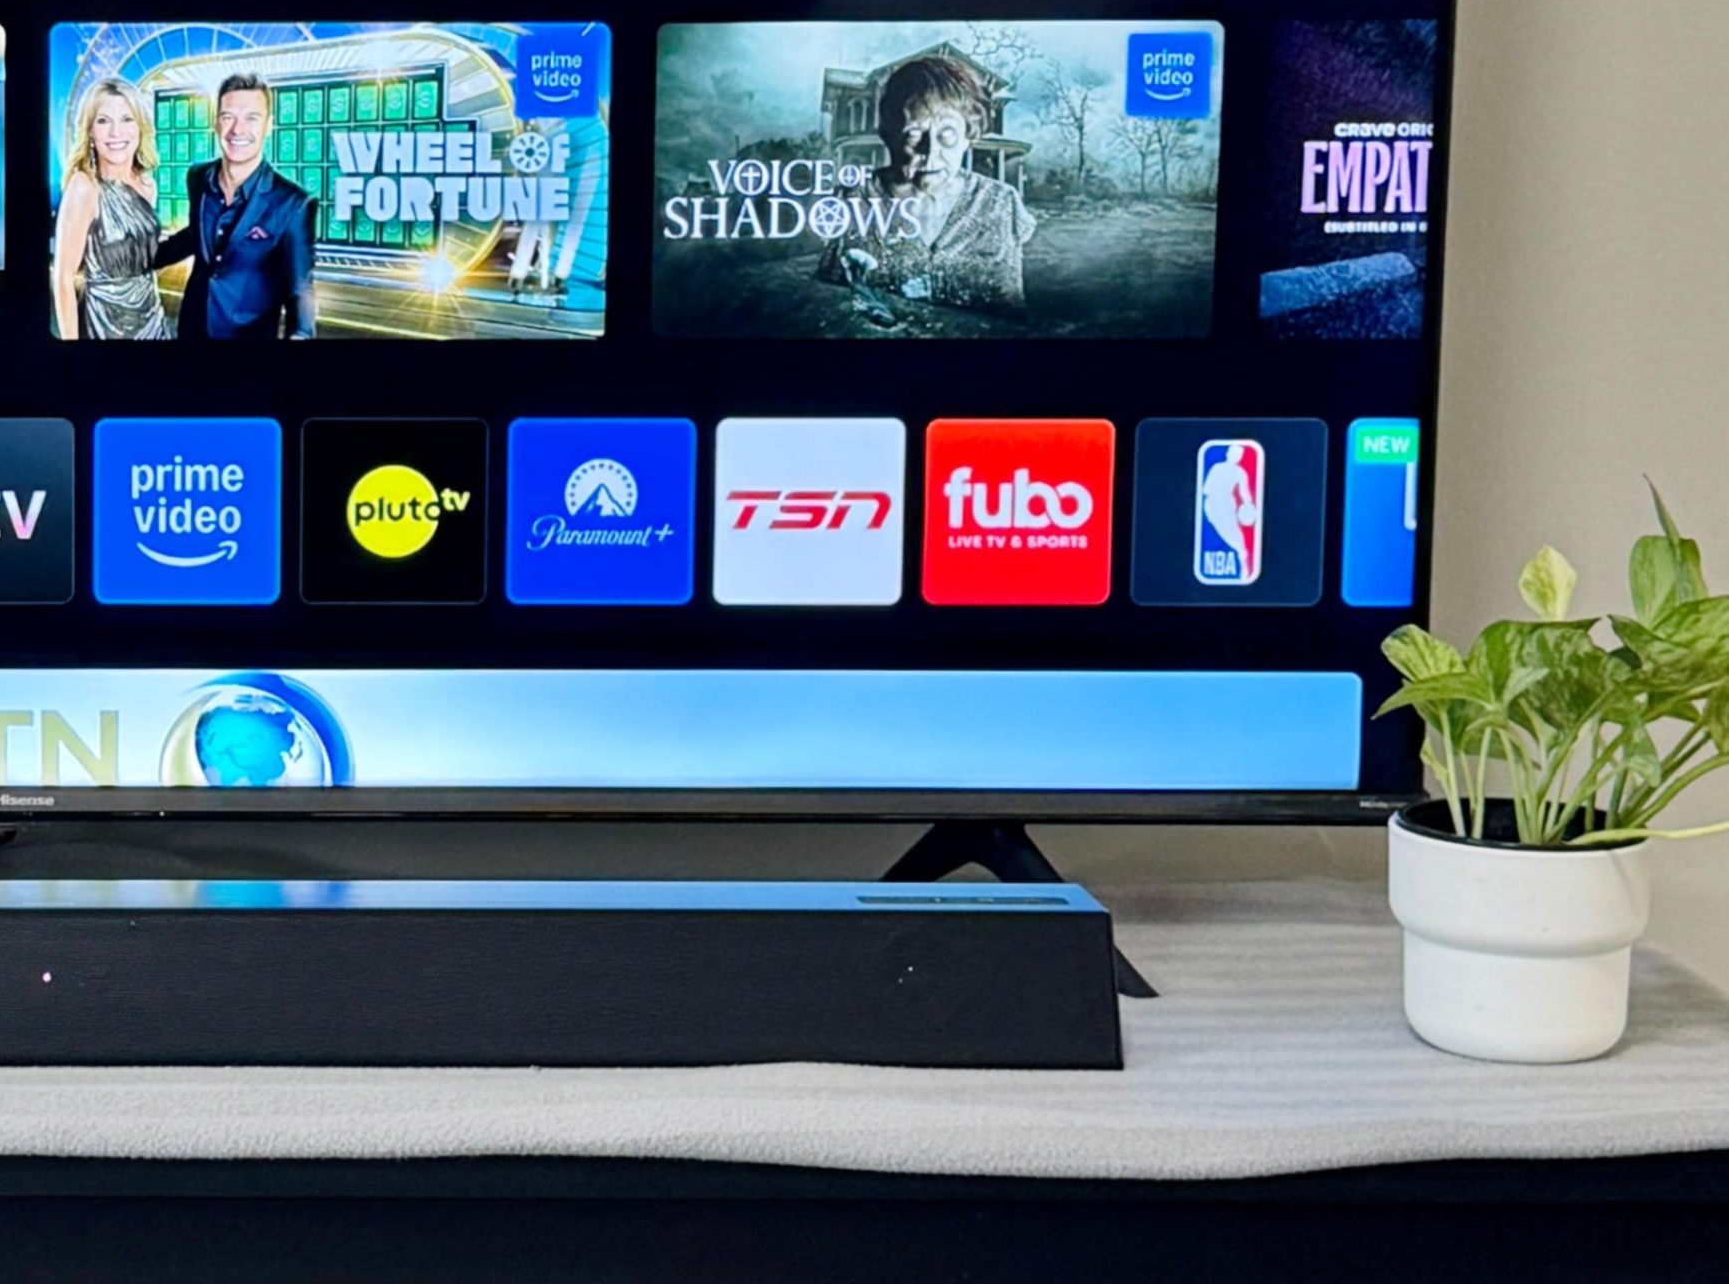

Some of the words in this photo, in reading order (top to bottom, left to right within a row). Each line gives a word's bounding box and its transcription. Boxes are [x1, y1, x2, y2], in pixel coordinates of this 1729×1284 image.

[531, 50, 583, 72] prime
[532, 69, 581, 88] video
[1141, 49, 1196, 71] prime
[1143, 68, 1195, 87] video
[332, 131, 502, 174] WHEEL
[707, 159, 836, 196] VOICE
[838, 164, 873, 188] OF
[334, 176, 571, 222] FORTUNE
[663, 196, 924, 240] SHADOWS
[1363, 435, 1410, 454] NEW
[131, 455, 245, 499] prime
[133, 496, 242, 534] video
[355, 496, 442, 527] pluto
[440, 487, 471, 512] tv
[726, 490, 892, 530] TSN
[943, 465, 1094, 529] fubo
[947, 535, 983, 549] LIVE
[986, 535, 1007, 549] TV
[1027, 535, 1089, 549] SPORTS
[1203, 550, 1238, 577] NBA
